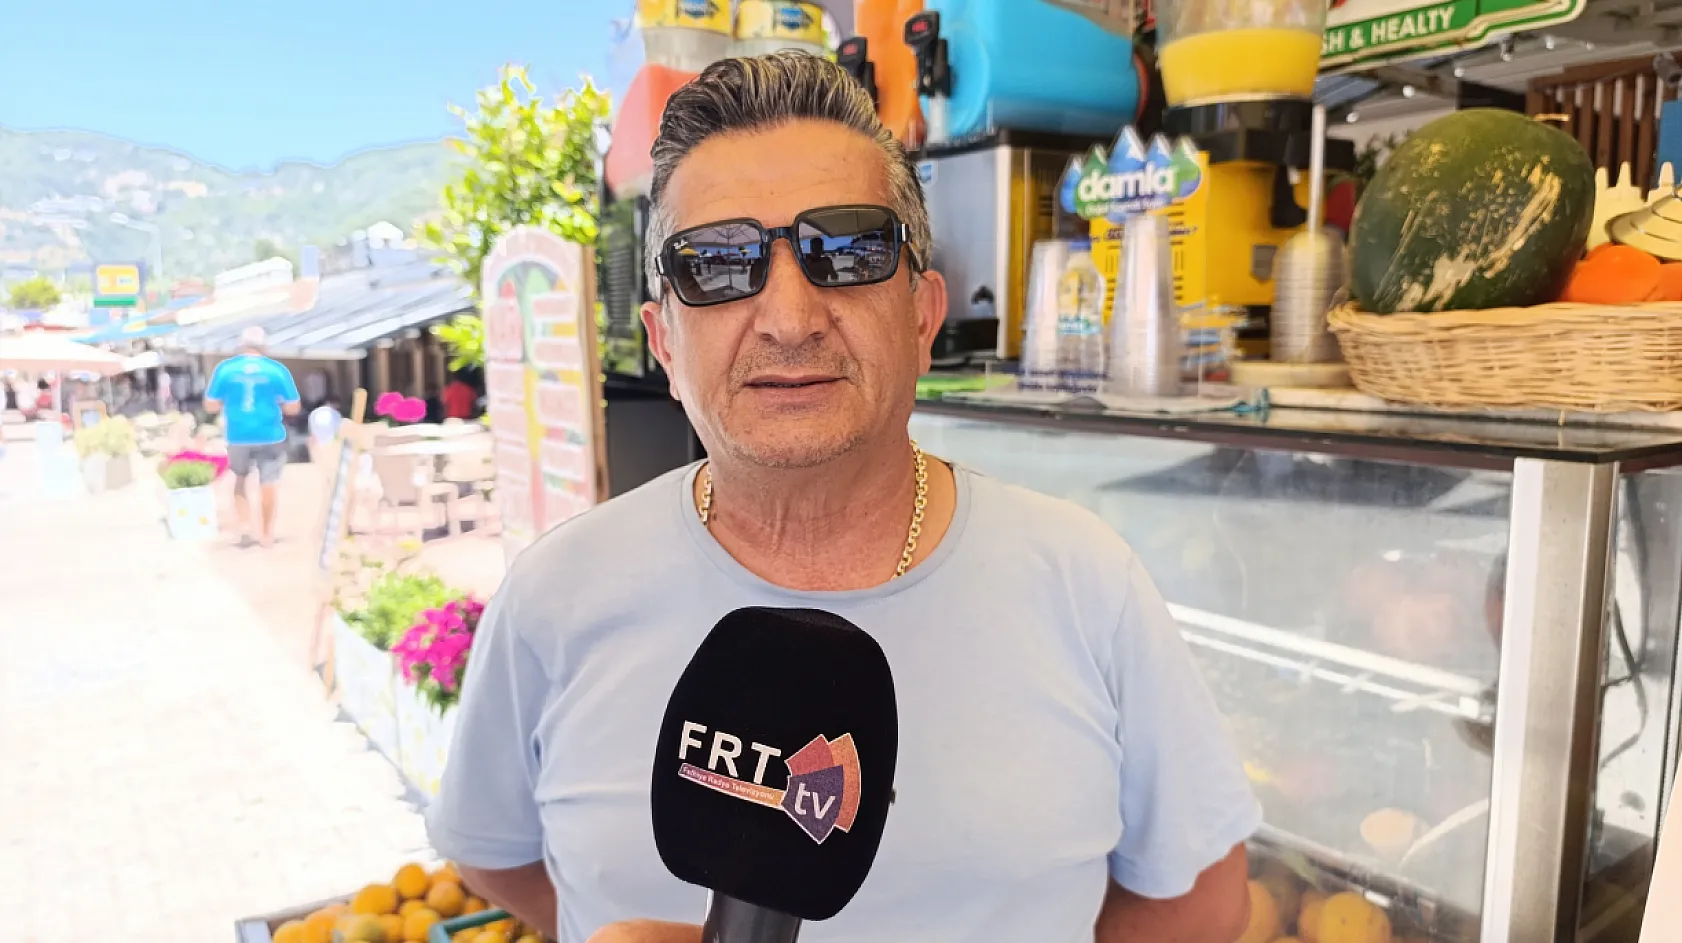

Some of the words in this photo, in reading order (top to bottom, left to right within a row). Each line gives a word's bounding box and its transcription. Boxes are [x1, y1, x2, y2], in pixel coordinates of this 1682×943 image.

[1348, 26, 1365, 49] &
[1370, 4, 1456, 45] HEALTY
[1077, 160, 1175, 202] damla
[678, 719, 782, 784] FRT
[794, 782, 836, 819] tv
